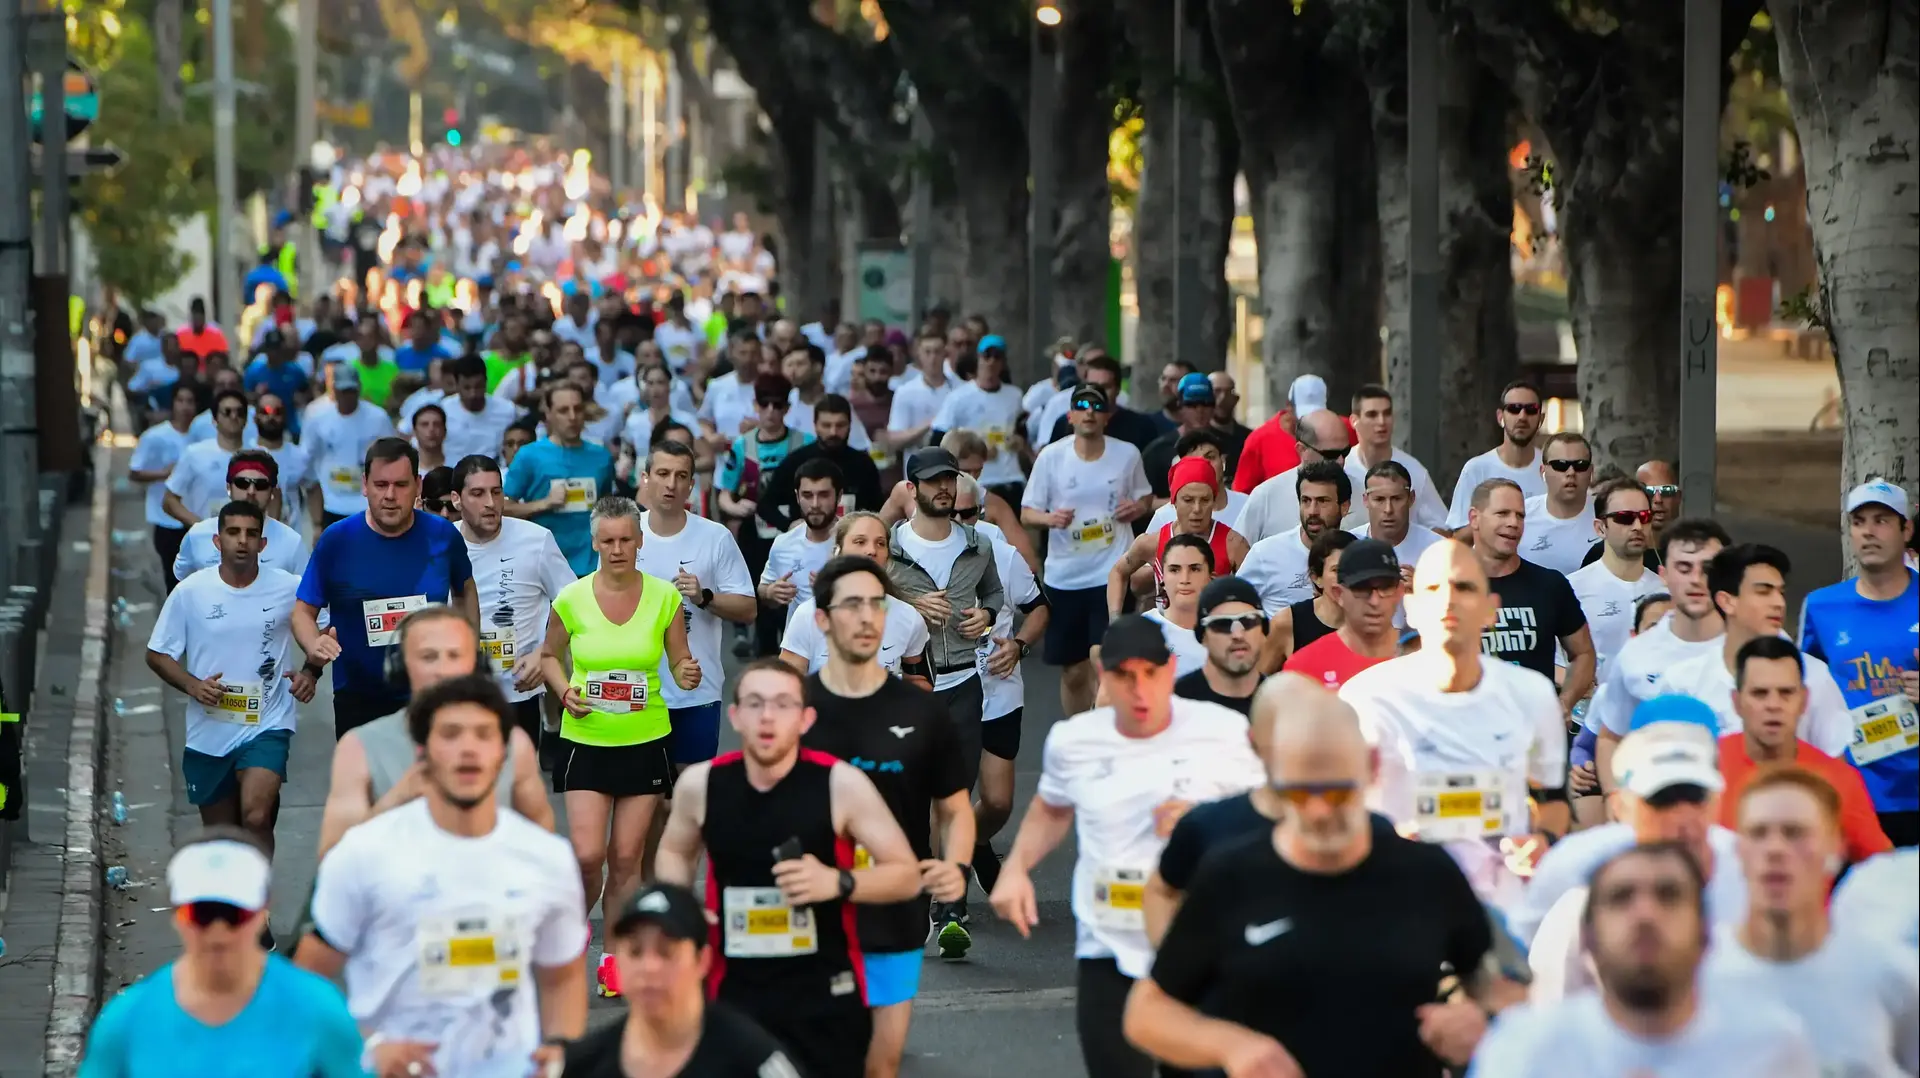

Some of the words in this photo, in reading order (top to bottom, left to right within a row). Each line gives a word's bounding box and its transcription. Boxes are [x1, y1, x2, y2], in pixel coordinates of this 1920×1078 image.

[1495, 607, 1537, 627] חייב
[1480, 626, 1537, 657] להתק
[225, 696, 247, 707] 10503
[264, 684, 273, 705] Aviv
